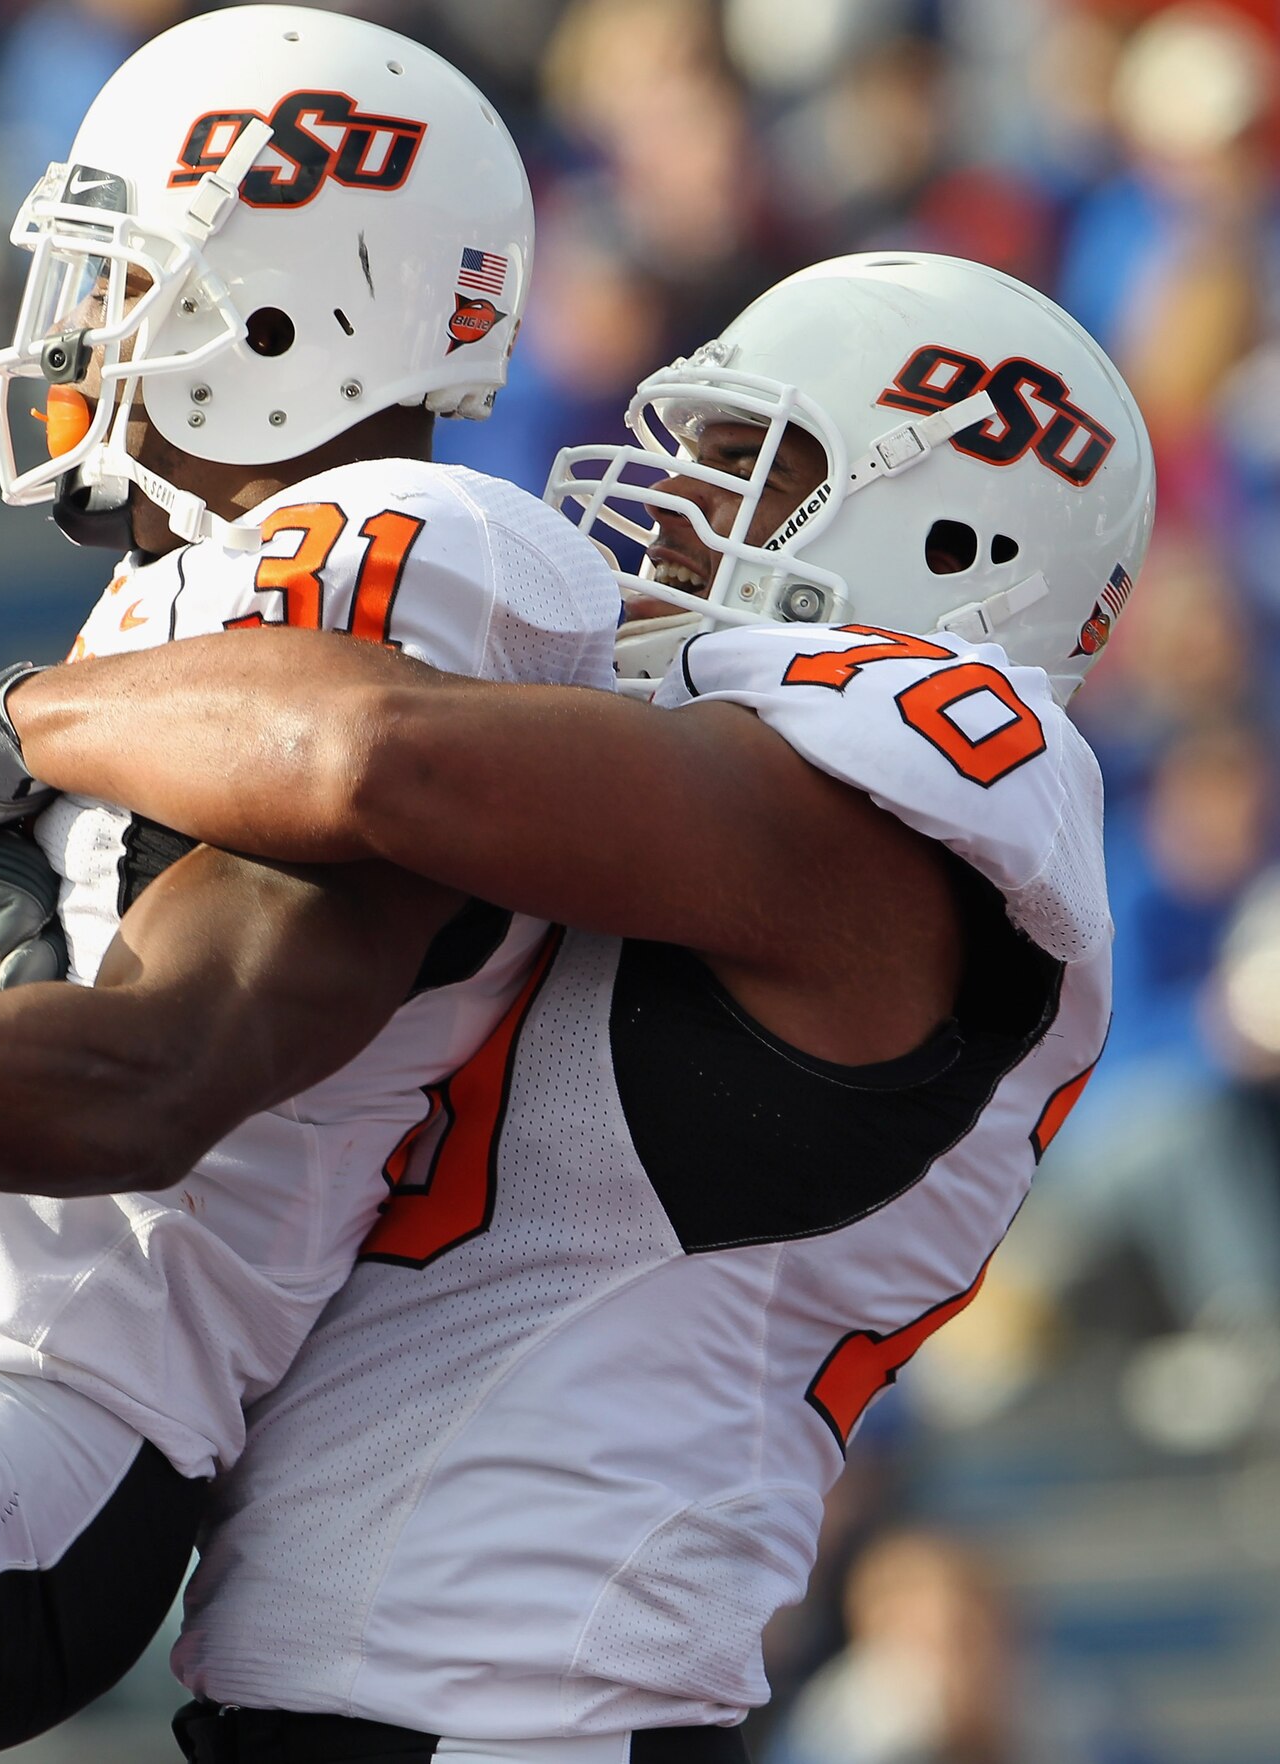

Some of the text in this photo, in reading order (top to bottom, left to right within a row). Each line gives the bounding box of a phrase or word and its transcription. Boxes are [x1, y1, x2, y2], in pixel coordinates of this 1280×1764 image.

[167, 89, 428, 209] OSU
[453, 314, 477, 329] BIG
[875, 344, 1116, 487] OSU
[223, 501, 426, 651] 31
[780, 623, 1047, 789] 70
